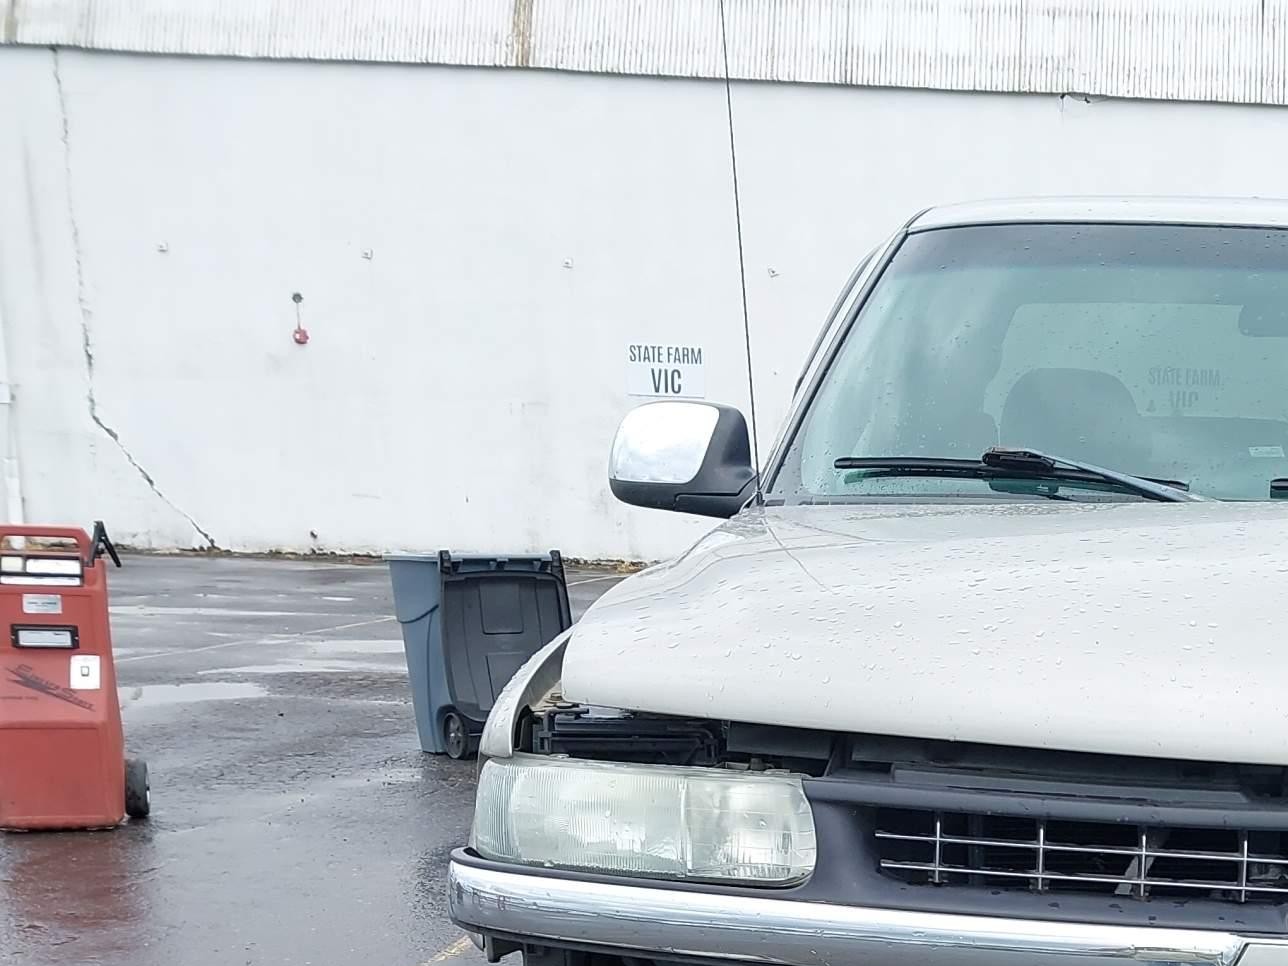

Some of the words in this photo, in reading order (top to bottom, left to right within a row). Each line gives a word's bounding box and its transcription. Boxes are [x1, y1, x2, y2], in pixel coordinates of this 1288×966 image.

[629, 345, 663, 363] STATE
[667, 346, 702, 365] FARM
[650, 368, 682, 394] VIC
[1149, 367, 1182, 385] STATE
